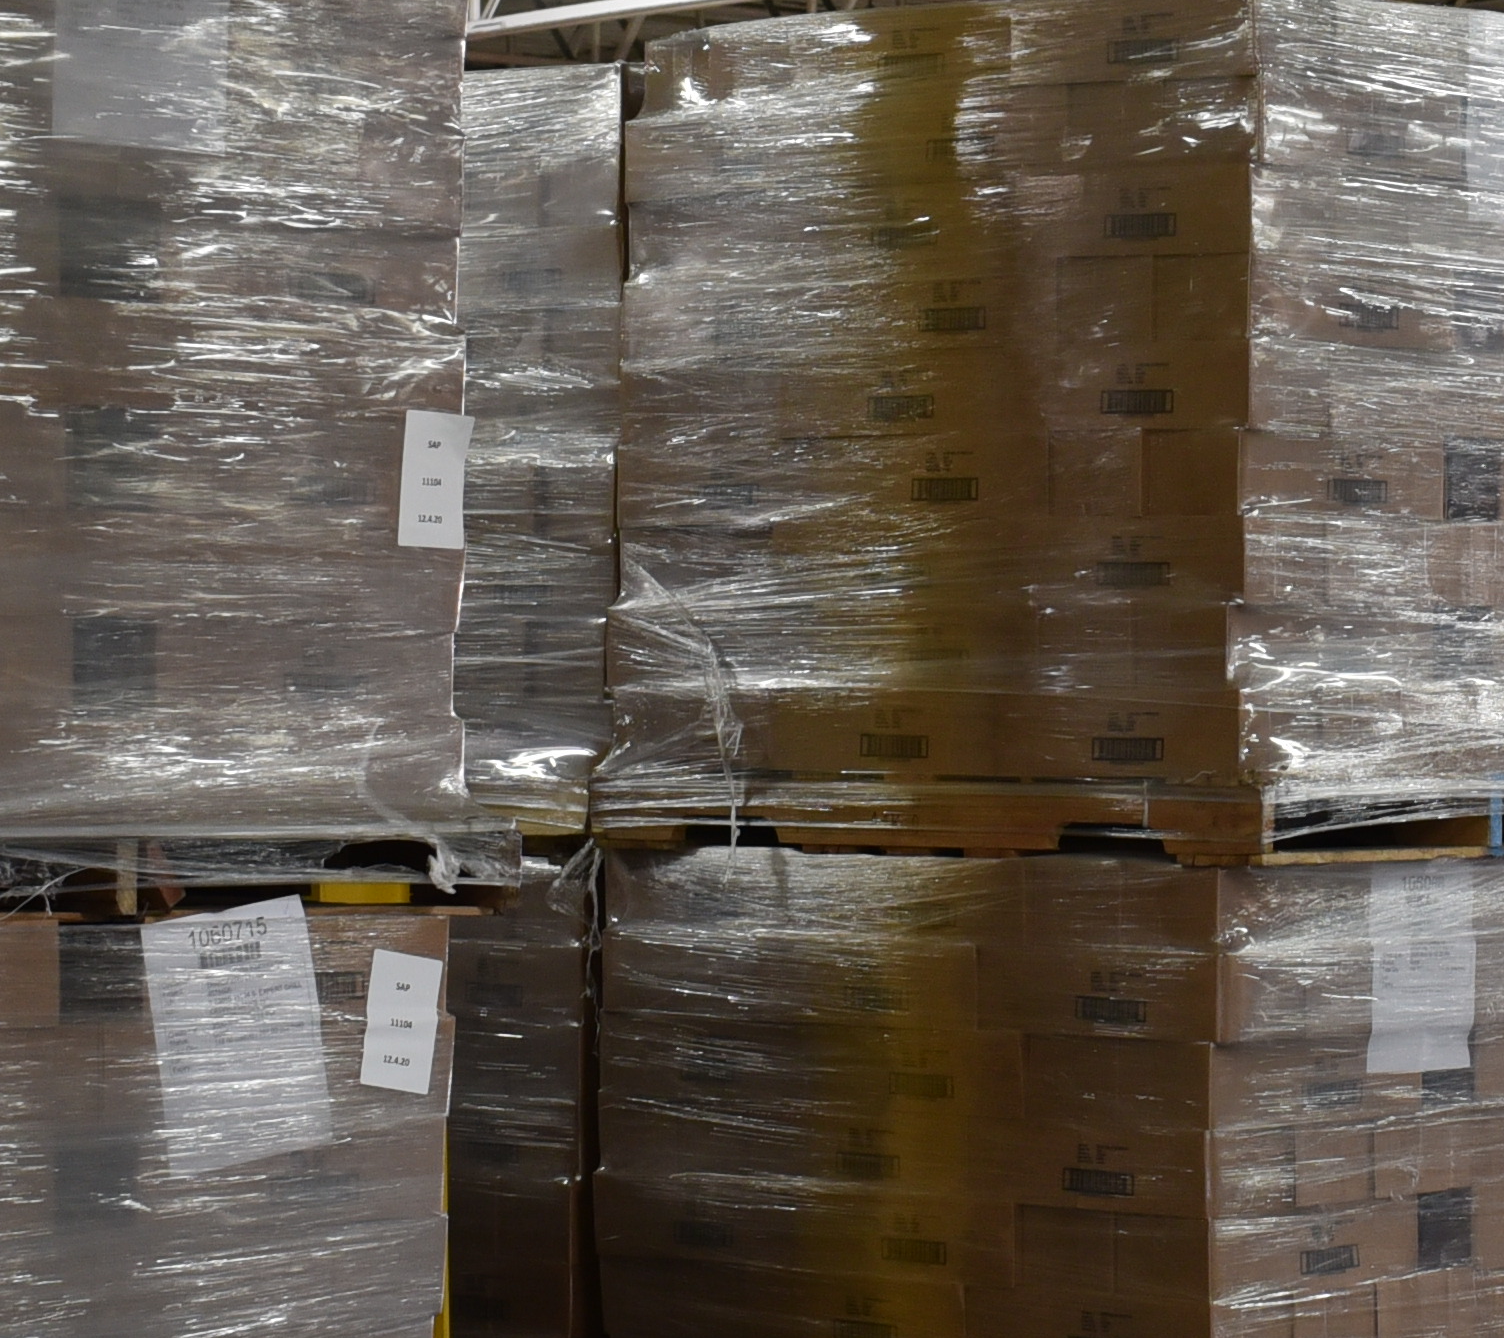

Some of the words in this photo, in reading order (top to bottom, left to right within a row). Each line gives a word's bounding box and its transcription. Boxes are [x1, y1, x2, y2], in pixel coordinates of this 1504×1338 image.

[428, 440, 441, 448] SAP
[422, 478, 441, 486] 11104
[418, 514, 442, 524] 12.4.20
[396, 982, 410, 991] SAP
[390, 1018, 412, 1029] 11104
[383, 1055, 410, 1066] 12.4.20
